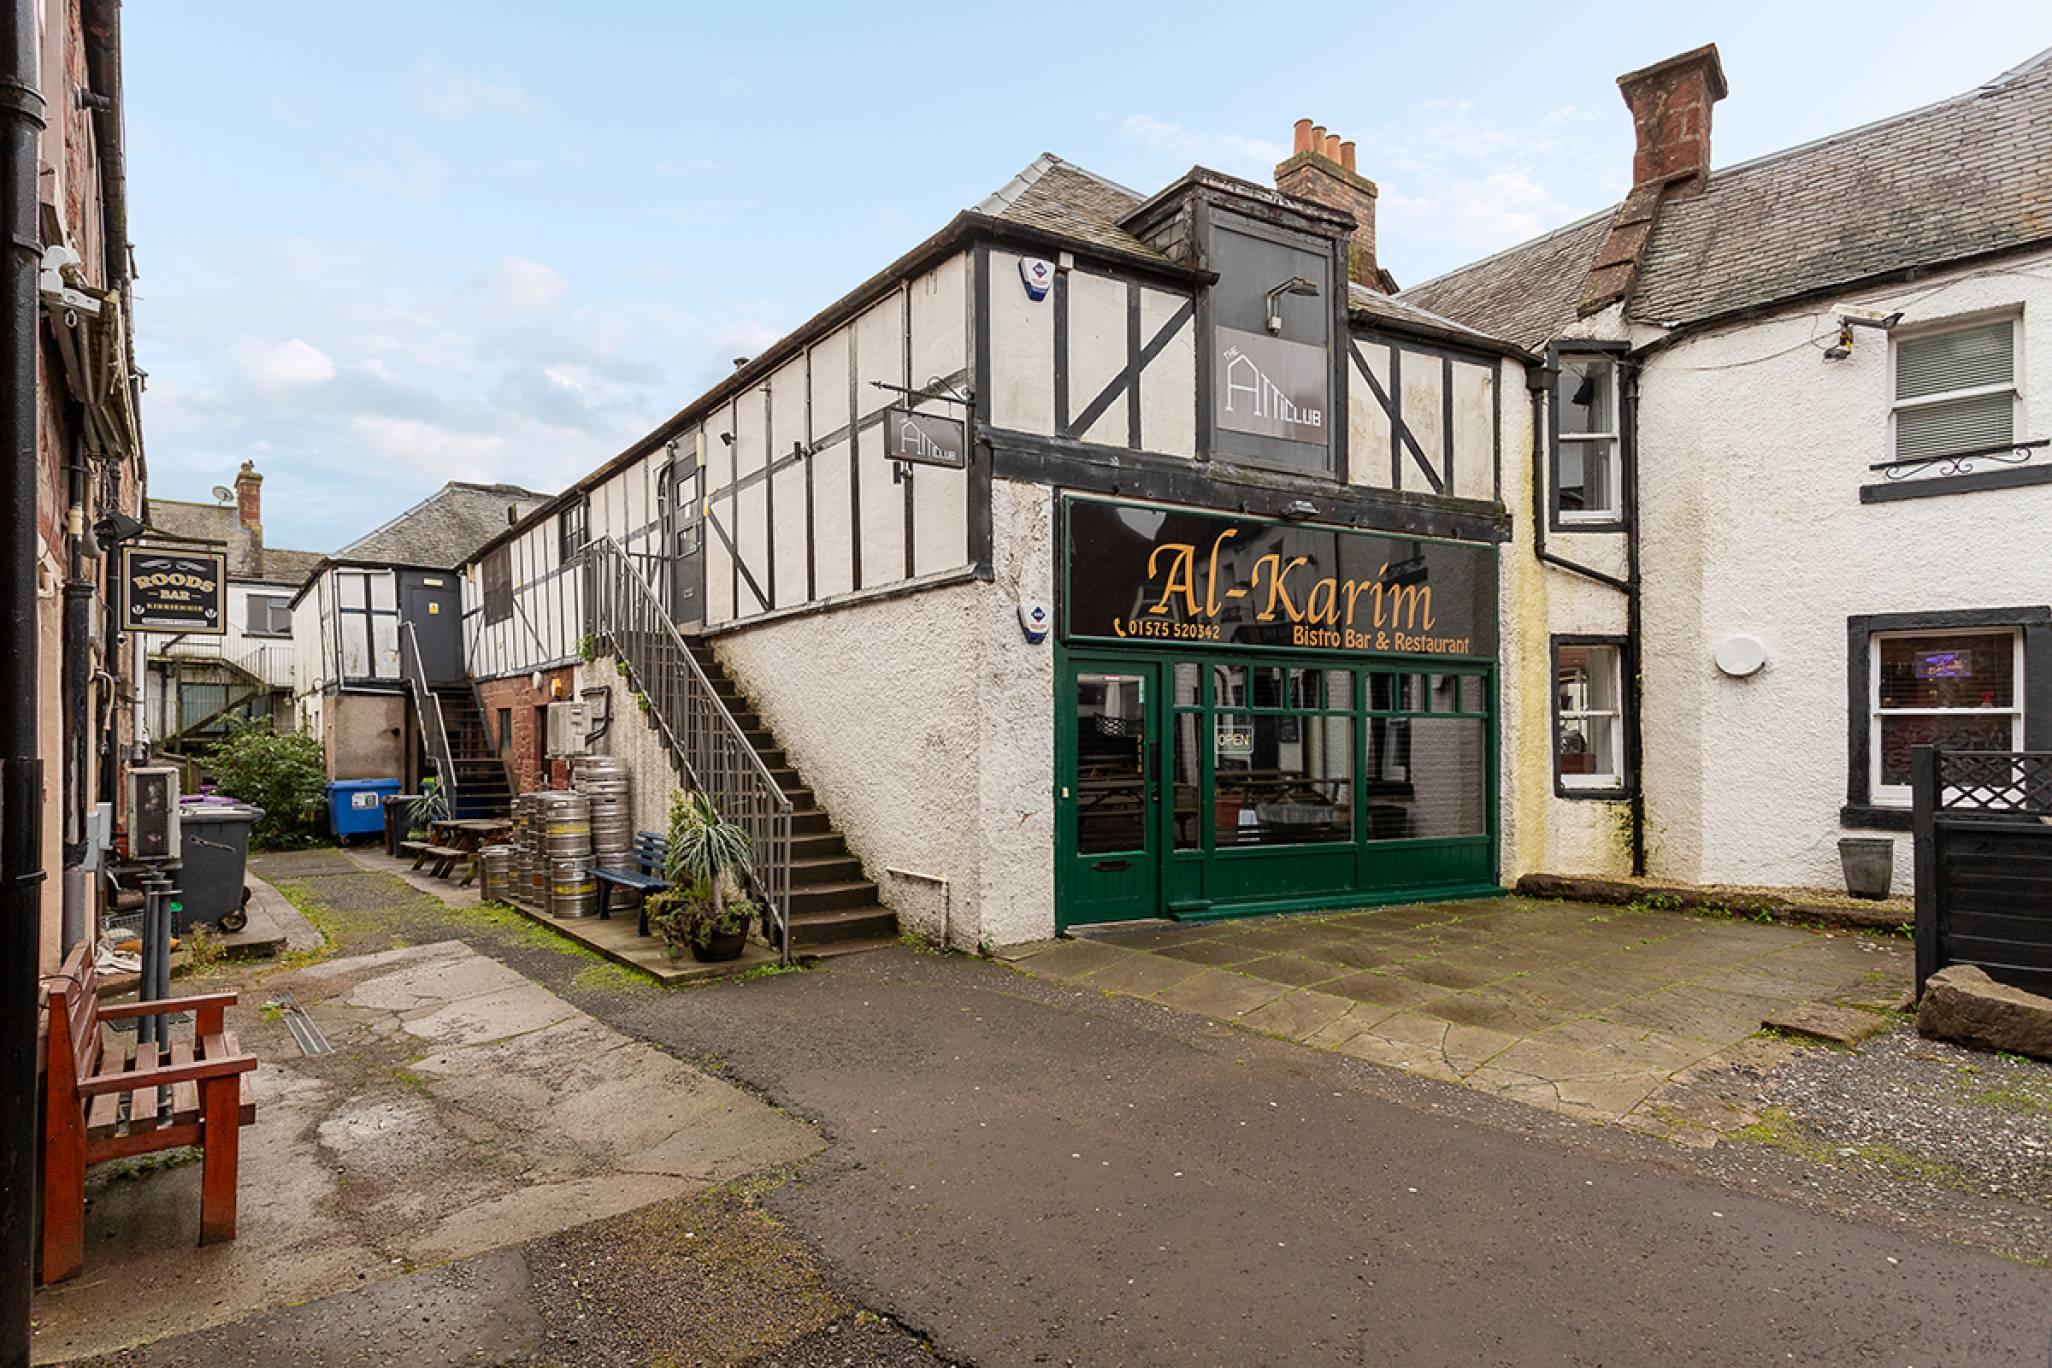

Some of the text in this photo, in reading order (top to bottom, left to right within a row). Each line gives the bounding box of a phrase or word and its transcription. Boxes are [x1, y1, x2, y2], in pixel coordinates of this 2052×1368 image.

[132, 573, 216, 592] ROODS
[1148, 528, 1436, 632] Al-Karim
[1128, 619, 1170, 637] 01575
[1293, 625, 1470, 654] Bistro Bar & Restaurant
[1218, 733, 1249, 747] OPEN
